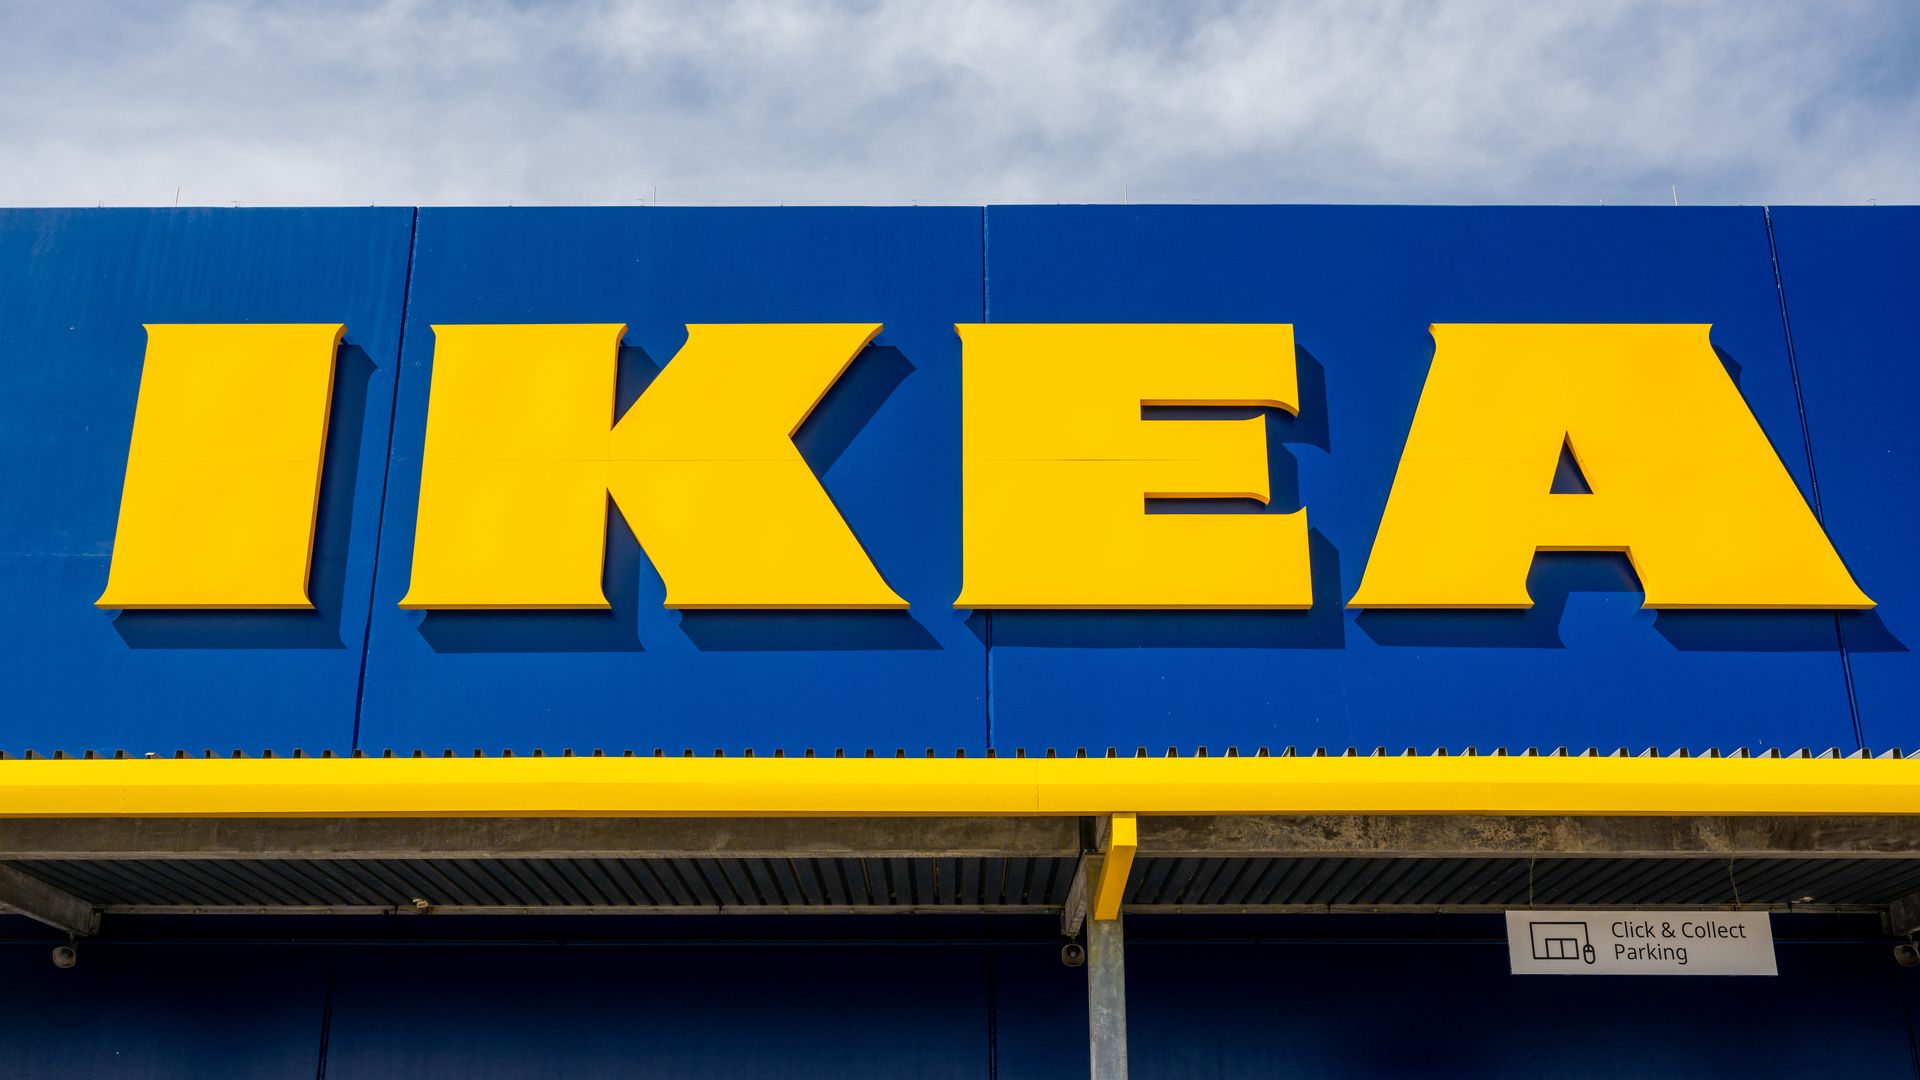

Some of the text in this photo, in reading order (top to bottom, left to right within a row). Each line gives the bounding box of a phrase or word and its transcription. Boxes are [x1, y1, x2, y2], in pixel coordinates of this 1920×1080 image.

[96, 324, 1876, 609] IKEA
[1611, 921, 1747, 939] Click & Collect
[1614, 943, 1689, 965] Parking
